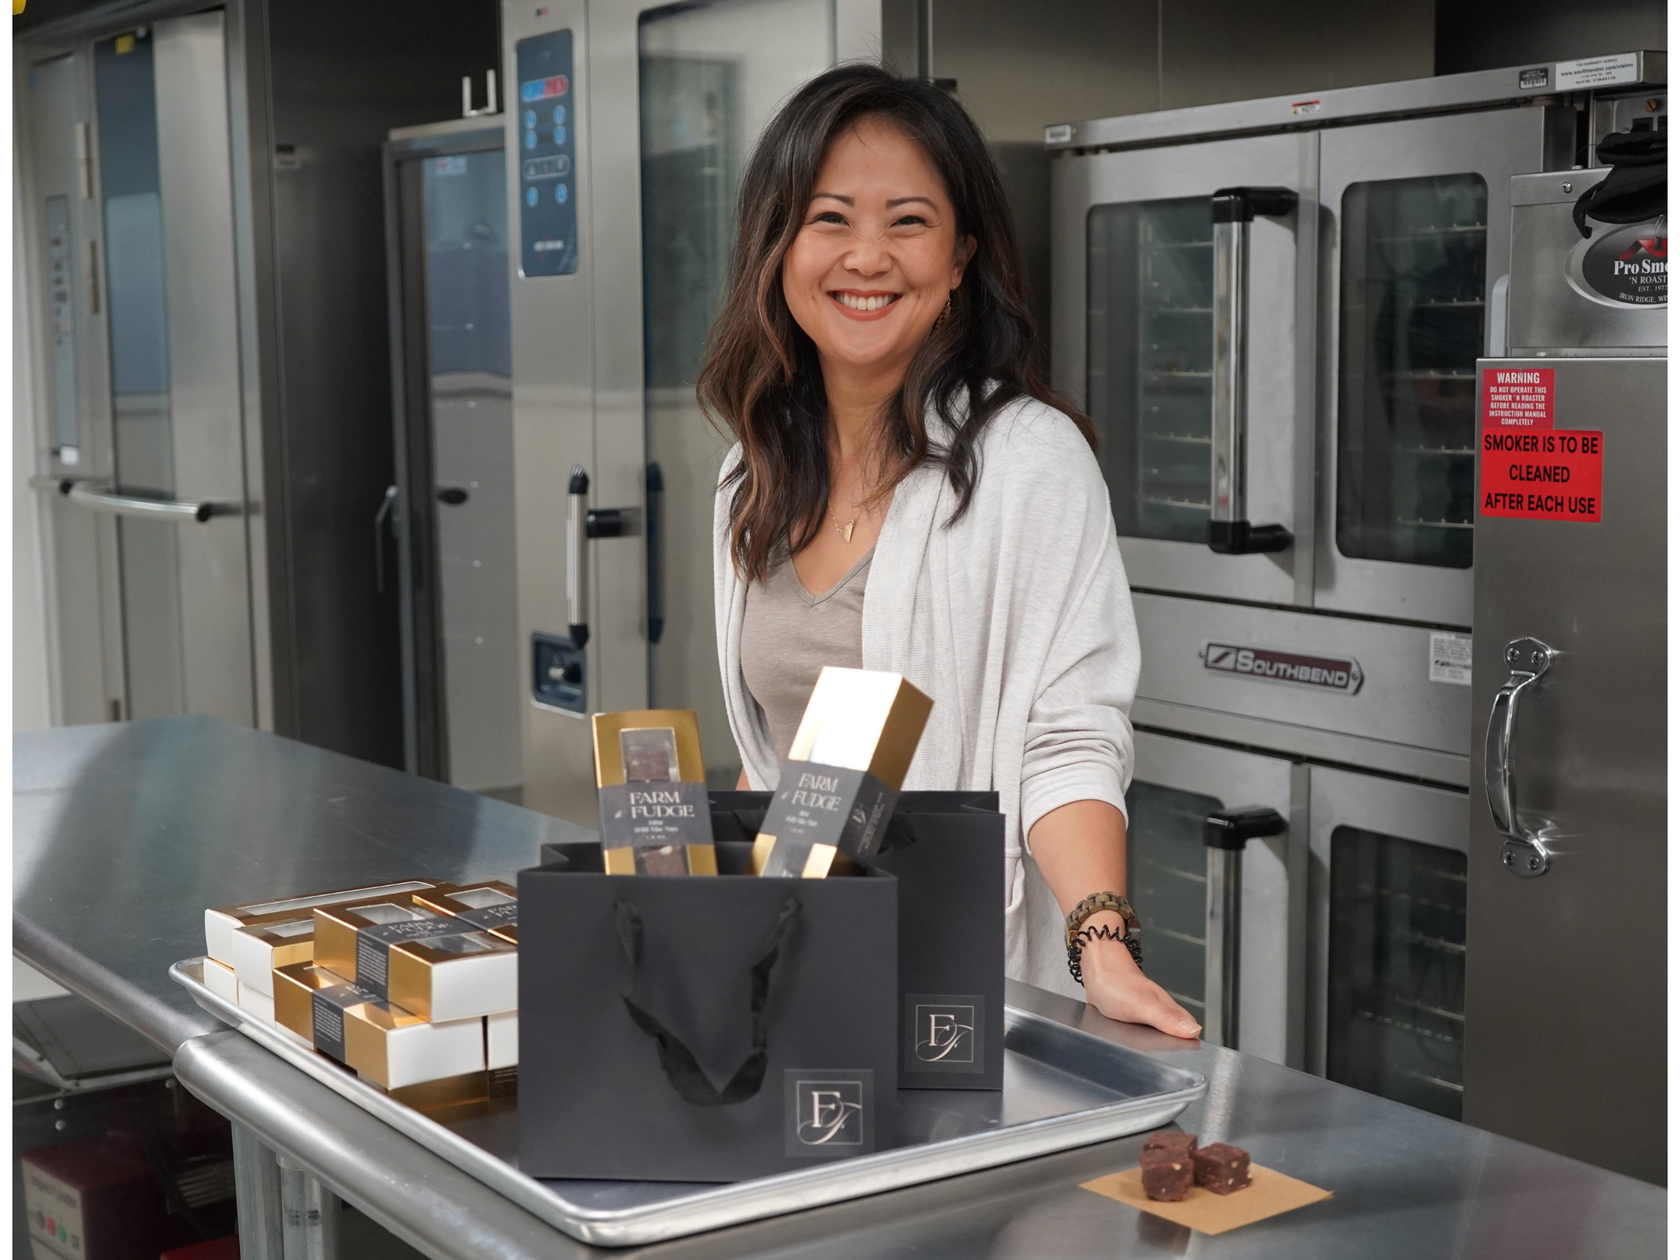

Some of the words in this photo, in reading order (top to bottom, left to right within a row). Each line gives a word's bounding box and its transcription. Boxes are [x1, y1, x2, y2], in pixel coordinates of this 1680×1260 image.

[1614, 261, 1640, 275] Pro
[1629, 276, 1638, 284] 'N
[1619, 292, 1634, 302] IRON
[1497, 372, 1540, 384] WARNING
[1521, 394, 1545, 402] ROASTER
[1511, 402, 1534, 410] READING
[1535, 402, 1546, 410] THE
[1524, 410, 1546, 418] MANUAL
[1501, 418, 1534, 426] COMPLETELY
[1484, 434, 1539, 452] SMOKER
[1542, 436, 1555, 453] IS
[1559, 436, 1578, 453] TO
[1581, 437, 1598, 454] BE
[1509, 464, 1570, 483] CLEANED
[1485, 492, 1524, 510] AFTER
[1528, 495, 1564, 512] EACH
[1568, 497, 1595, 514] USE
[798, 772, 838, 793] FARM
[629, 791, 680, 805] FARM
[791, 790, 842, 811] FUDGE
[631, 805, 695, 819] FUDGE
